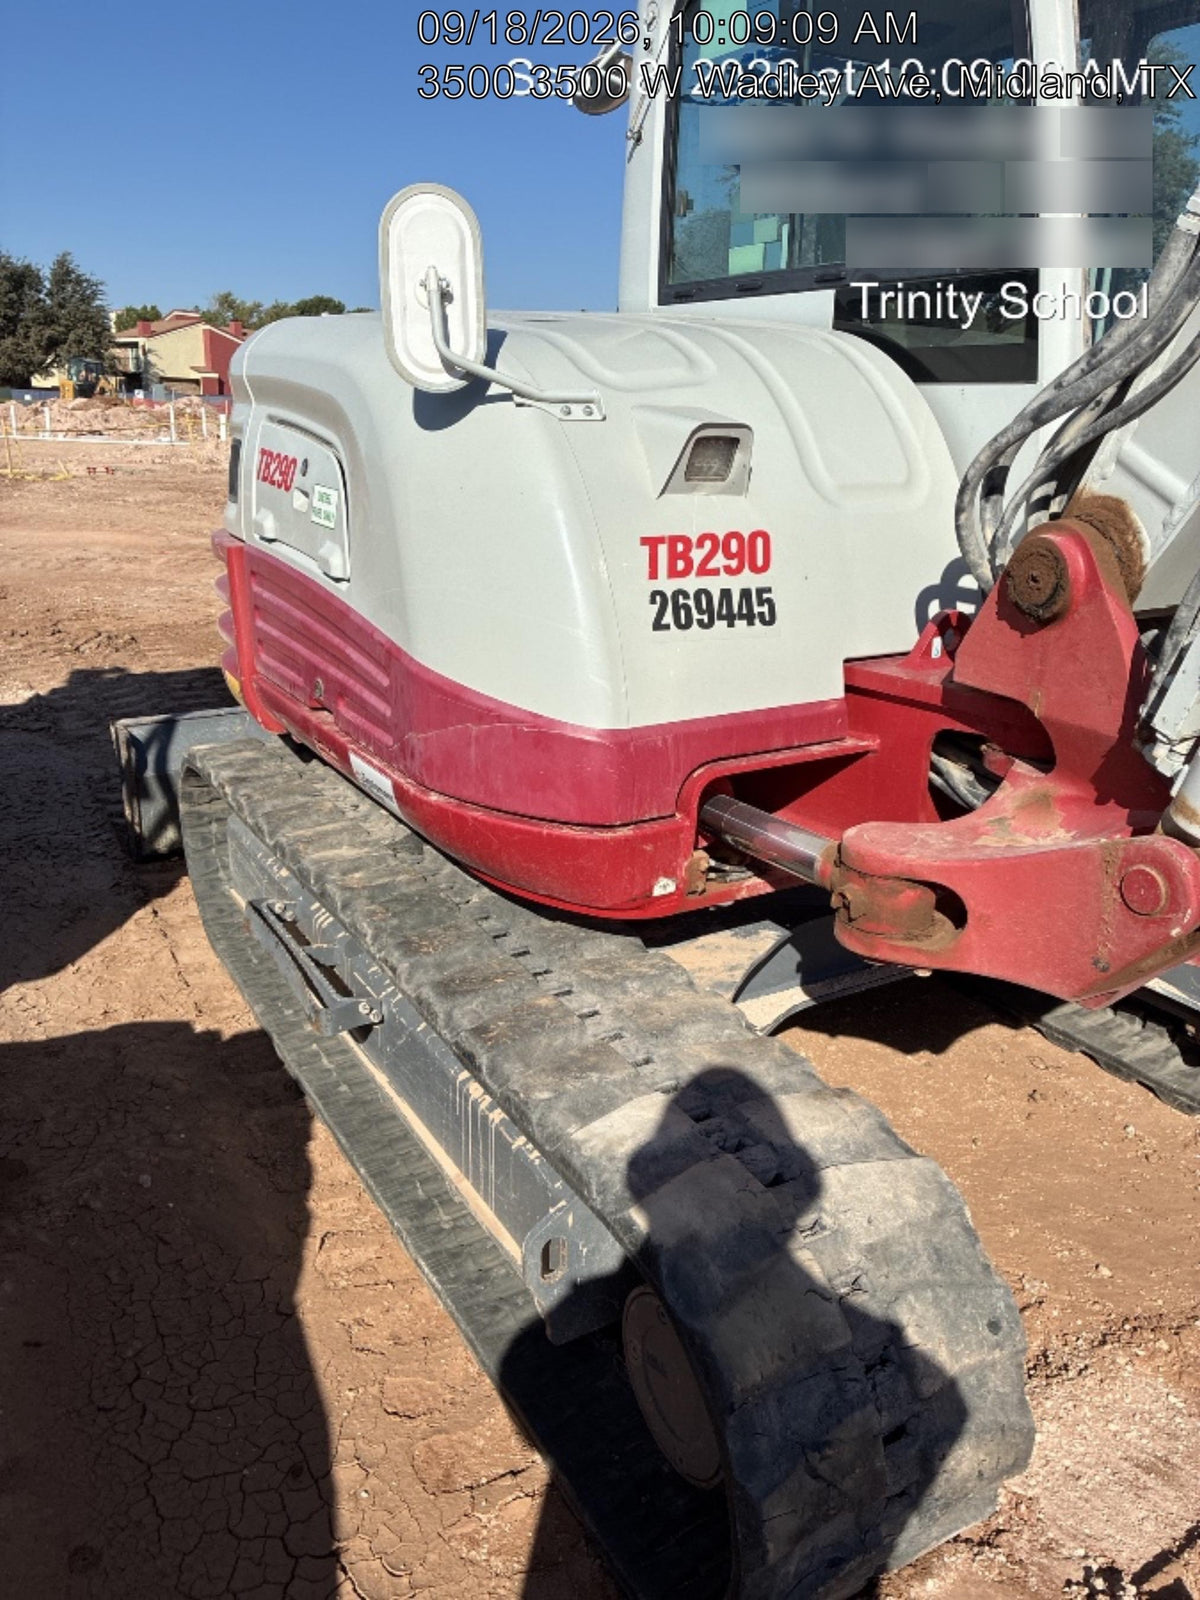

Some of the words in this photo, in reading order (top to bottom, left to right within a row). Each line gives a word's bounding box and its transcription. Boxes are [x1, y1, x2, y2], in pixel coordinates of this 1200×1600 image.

[256, 447, 298, 492] TB290
[640, 530, 772, 580] TB290
[649, 586, 777, 631] 269445
